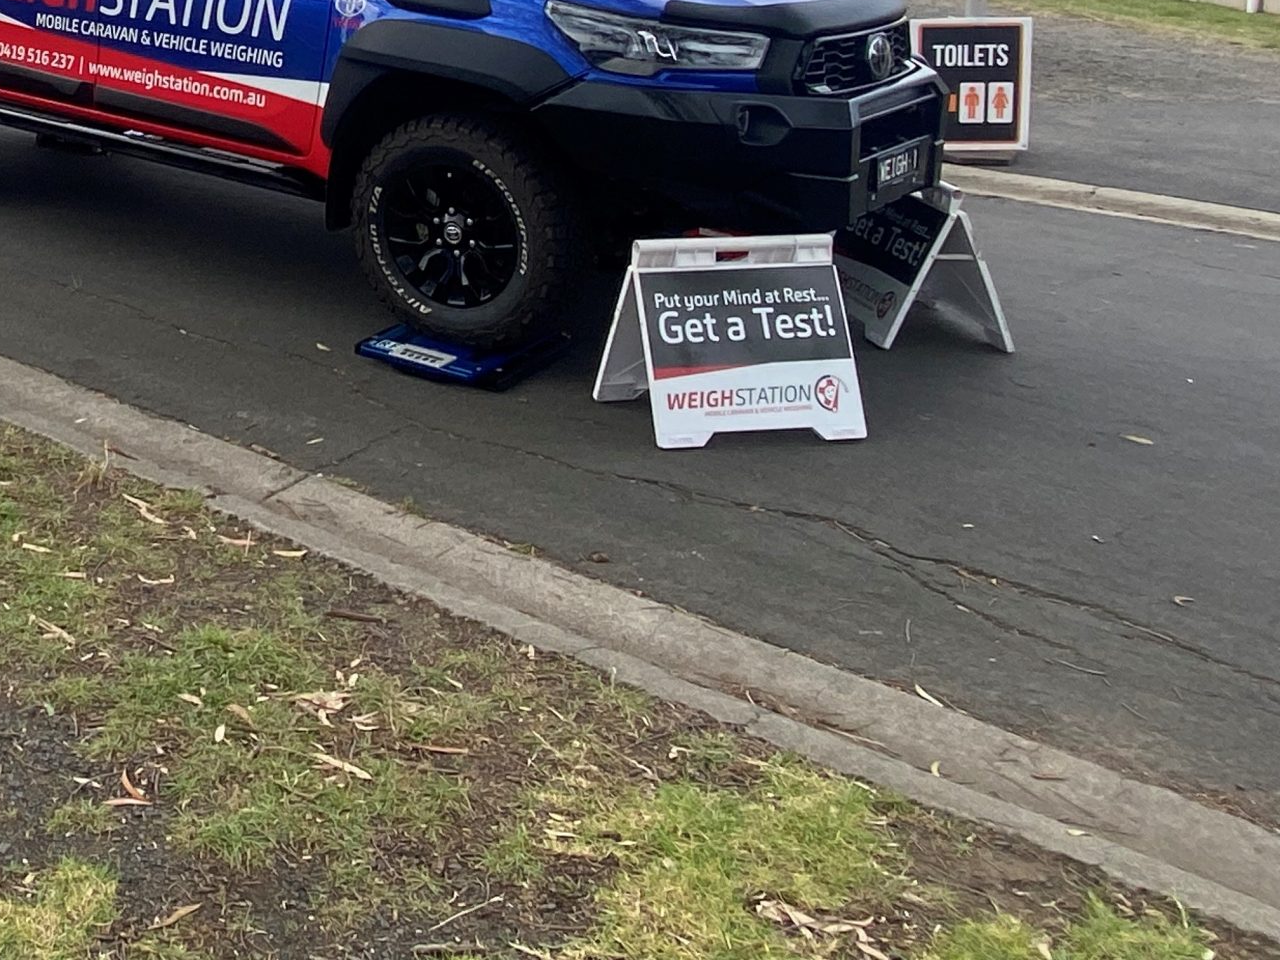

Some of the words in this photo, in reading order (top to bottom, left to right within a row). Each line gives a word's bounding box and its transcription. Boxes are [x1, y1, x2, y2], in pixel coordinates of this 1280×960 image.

[36, 13, 78, 34] MOBILE
[81, 20, 138, 44] CARAVAN
[140, 30, 150, 45] &
[153, 32, 206, 55] VEHICLE
[210, 41, 283, 68] WEIGHING
[932, 43, 1009, 66] TOILETS
[26, 49, 49, 65] 516
[51, 53, 75, 70] 237
[88, 60, 266, 108] www.weighstation.com.au
[654, 293, 681, 309] Put
[684, 294, 720, 311] your
[723, 288, 761, 306] Mind
[765, 289, 780, 304] at
[658, 310, 720, 344] Get
[727, 315, 746, 341] a
[752, 305, 836, 340] Test!
